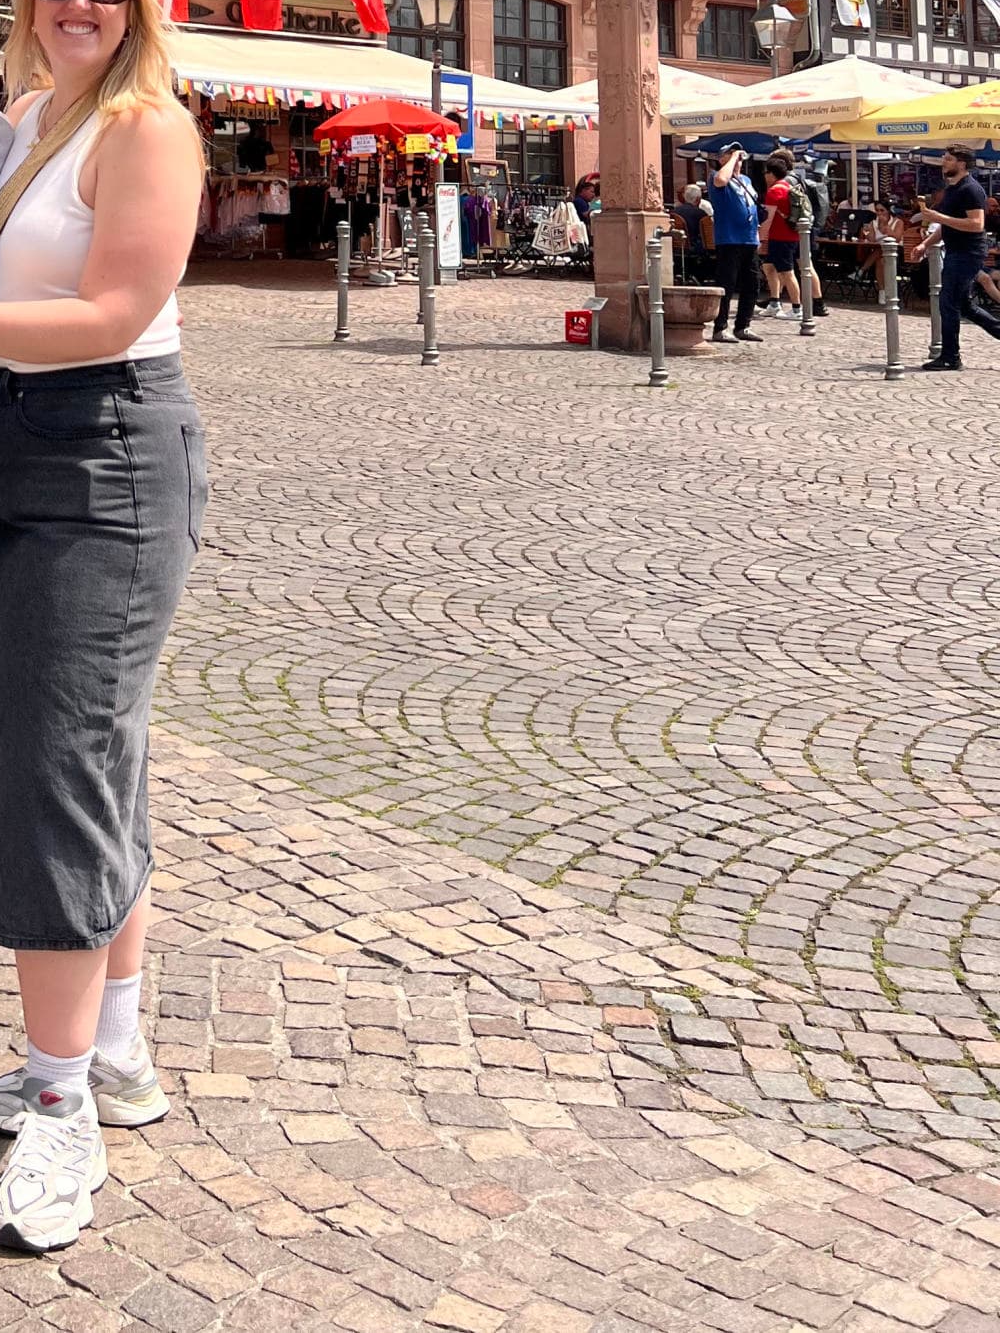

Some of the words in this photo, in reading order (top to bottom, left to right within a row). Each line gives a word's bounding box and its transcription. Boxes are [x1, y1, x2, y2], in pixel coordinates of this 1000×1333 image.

[225, 0, 361, 35] Ghenke
[722, 113, 736, 122] Das
[938, 121, 954, 131] Das
